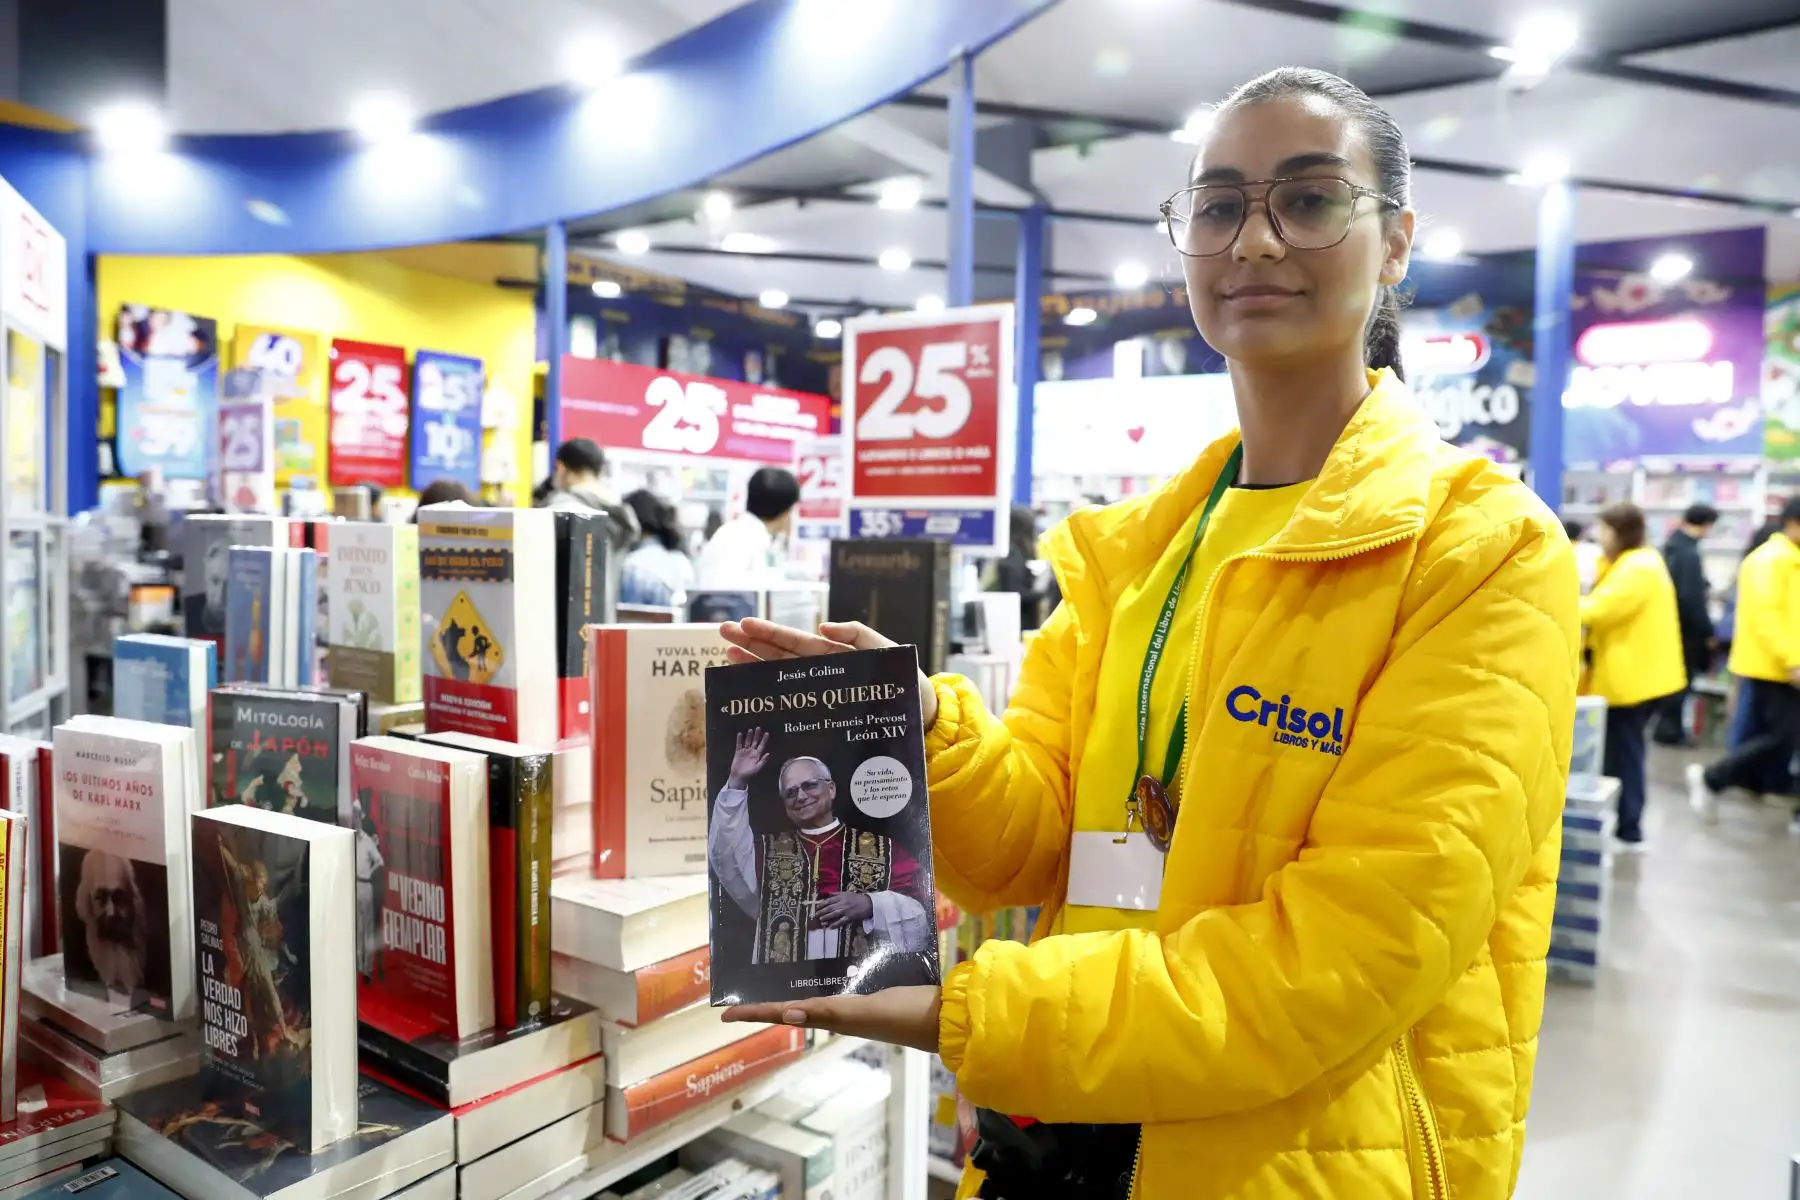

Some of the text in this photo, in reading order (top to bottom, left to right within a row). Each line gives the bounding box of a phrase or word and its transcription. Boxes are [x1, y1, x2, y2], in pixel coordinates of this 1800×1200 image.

[333, 359, 408, 414] 25
[856, 341, 973, 441] 25
[641, 376, 722, 454] 25
[1158, 610, 1172, 634] Libro
[656, 646, 728, 657] YUVAL NOA
[1154, 634, 1164, 650] del
[777, 666, 846, 683] Jesús Colina
[1140, 651, 1159, 715] Internacional
[720, 683, 906, 716] «DIOS NOS QUIERE»
[237, 706, 325, 731] MITOLOGÍA
[784, 713, 907, 733] Robert Francis Prevost
[1225, 685, 1344, 742] Crisol
[246, 728, 330, 759] JAPÓN
[846, 725, 908, 742] León XIV
[1273, 731, 1342, 756] LIBROS Y MÁS
[62, 770, 78, 784] LOS
[125, 780, 154, 797] AÑOS
[863, 776, 908, 788] pensamiento
[877, 768, 894, 776] vida,
[72, 789, 142, 813] DE KARL MARX
[857, 797, 871, 805] que
[880, 793, 907, 802] esperan
[399, 874, 446, 924] VECINO
[200, 918, 218, 936] PEDRO
[382, 906, 447, 965] EJEMPLAR
[200, 932, 224, 951] SALINAS
[202, 951, 215, 977] LA
[202, 975, 241, 1010] VERDAD
[790, 976, 849, 988] LIBROSLIBRES
[203, 999, 248, 1038] NOS HIZO
[204, 1022, 238, 1057] LIBRES
[685, 1059, 746, 1098] Sapiens
